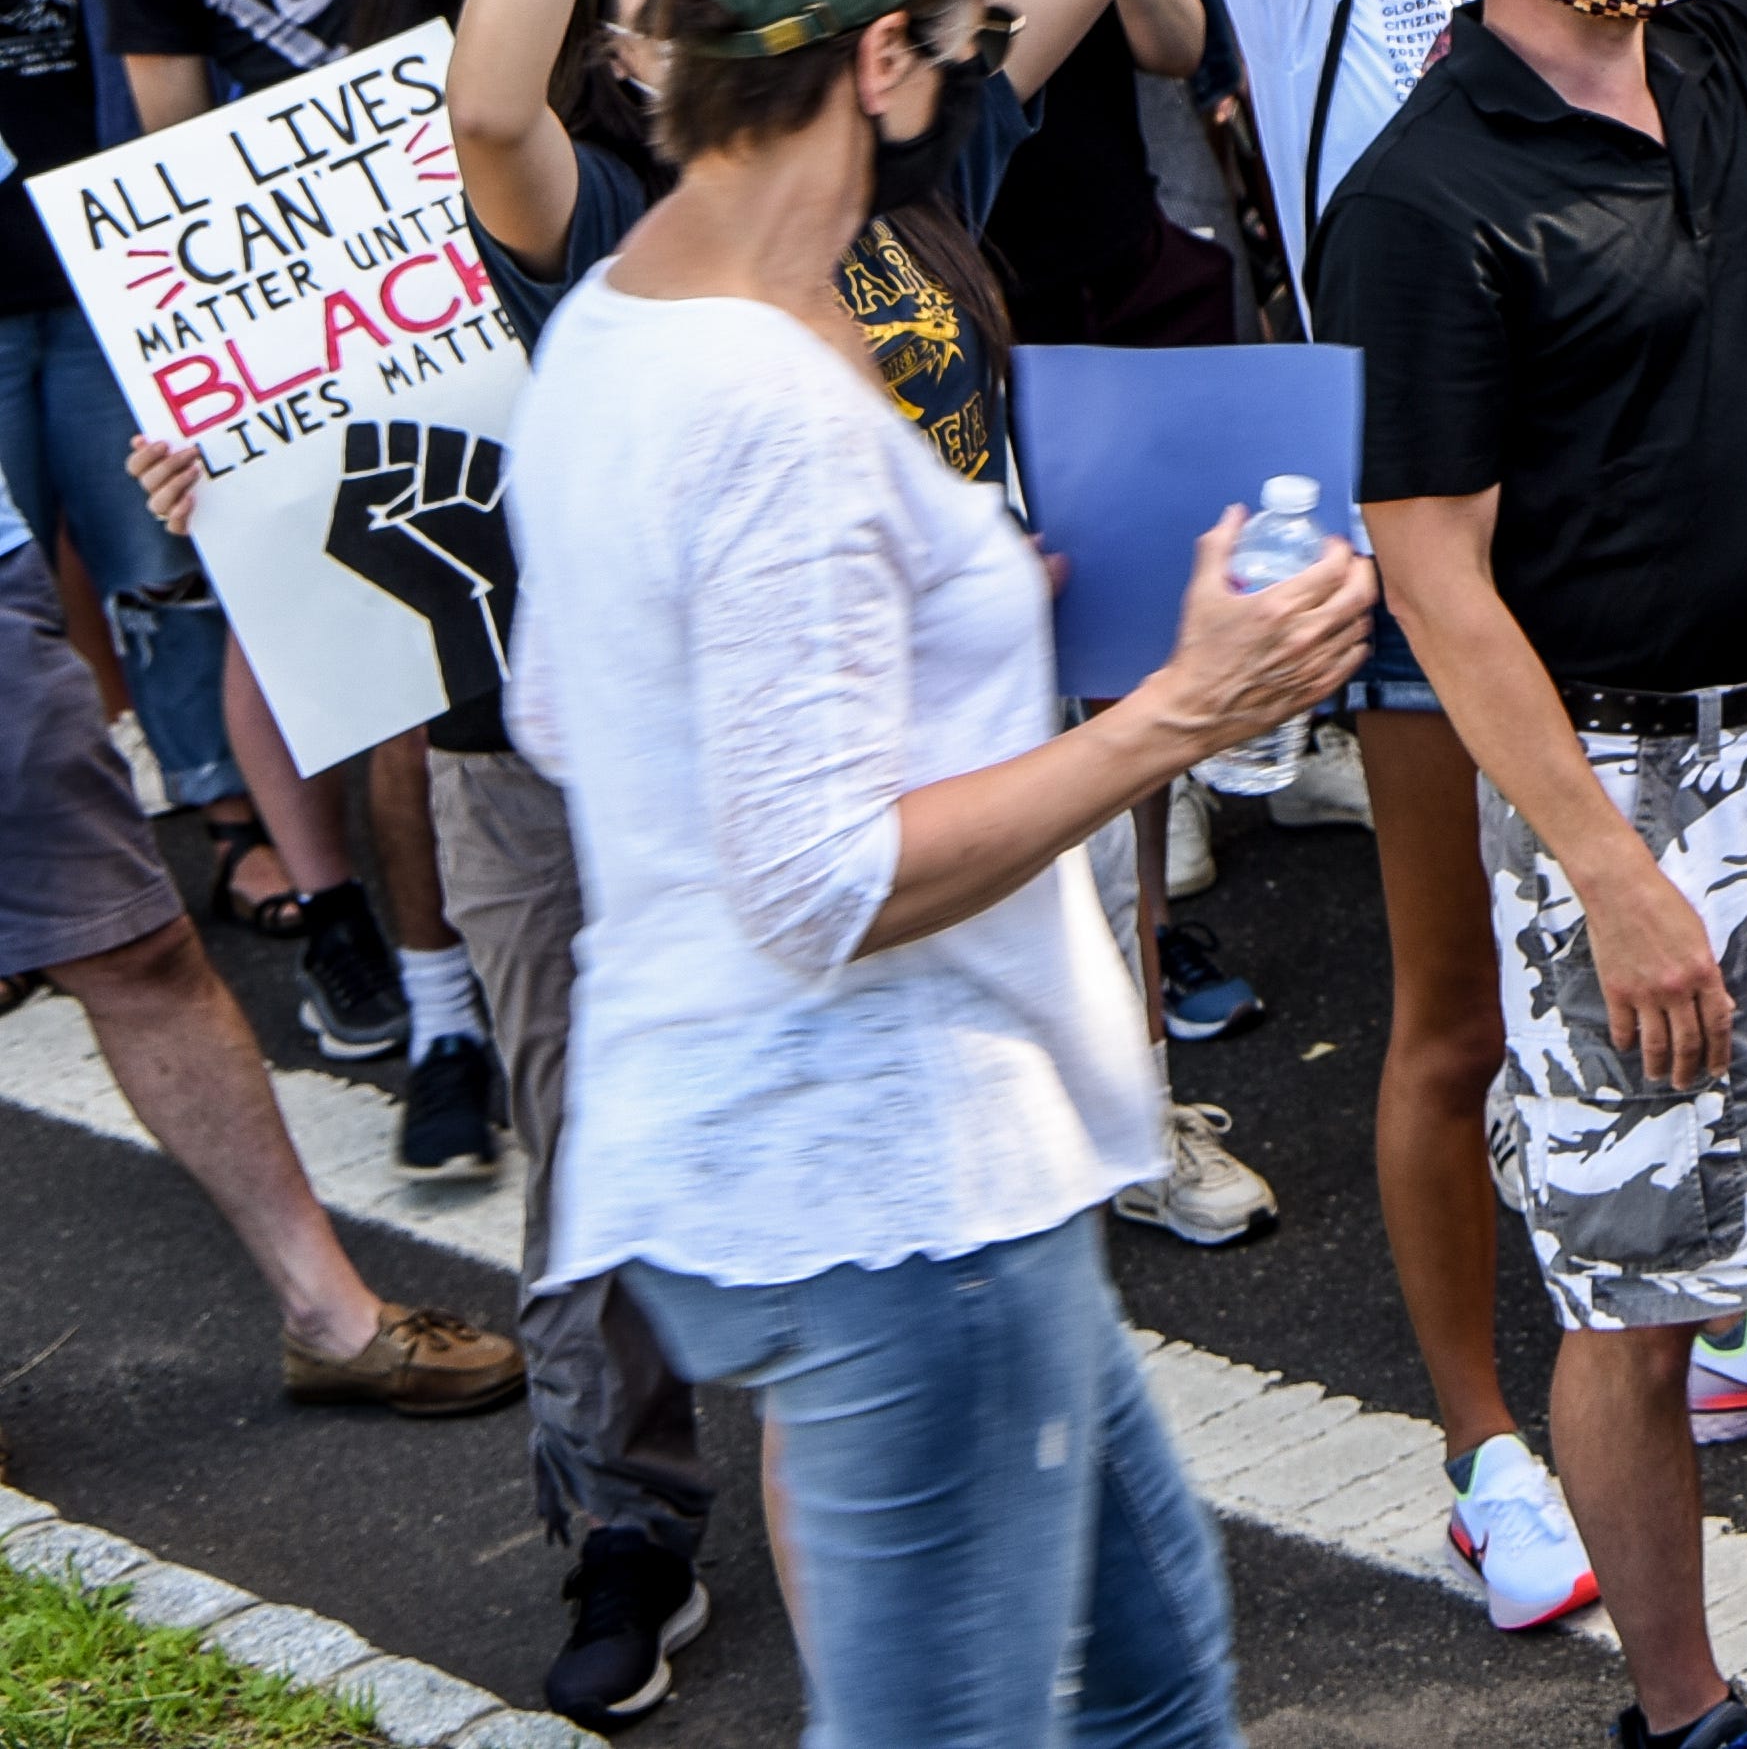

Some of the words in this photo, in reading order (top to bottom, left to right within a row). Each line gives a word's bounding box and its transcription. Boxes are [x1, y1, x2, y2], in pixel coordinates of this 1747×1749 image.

[1383, 11, 1447, 32] CITIZEN
[78, 161, 211, 253] ALL
[229, 54, 449, 188] LIVES
[176, 139, 395, 286] CAN'T
[133, 260, 324, 364] MATTER
[343, 190, 468, 271] UNTI
[152, 240, 495, 439] BLACK
[199, 380, 353, 481] LIVES
[377, 305, 520, 396] MATTE
